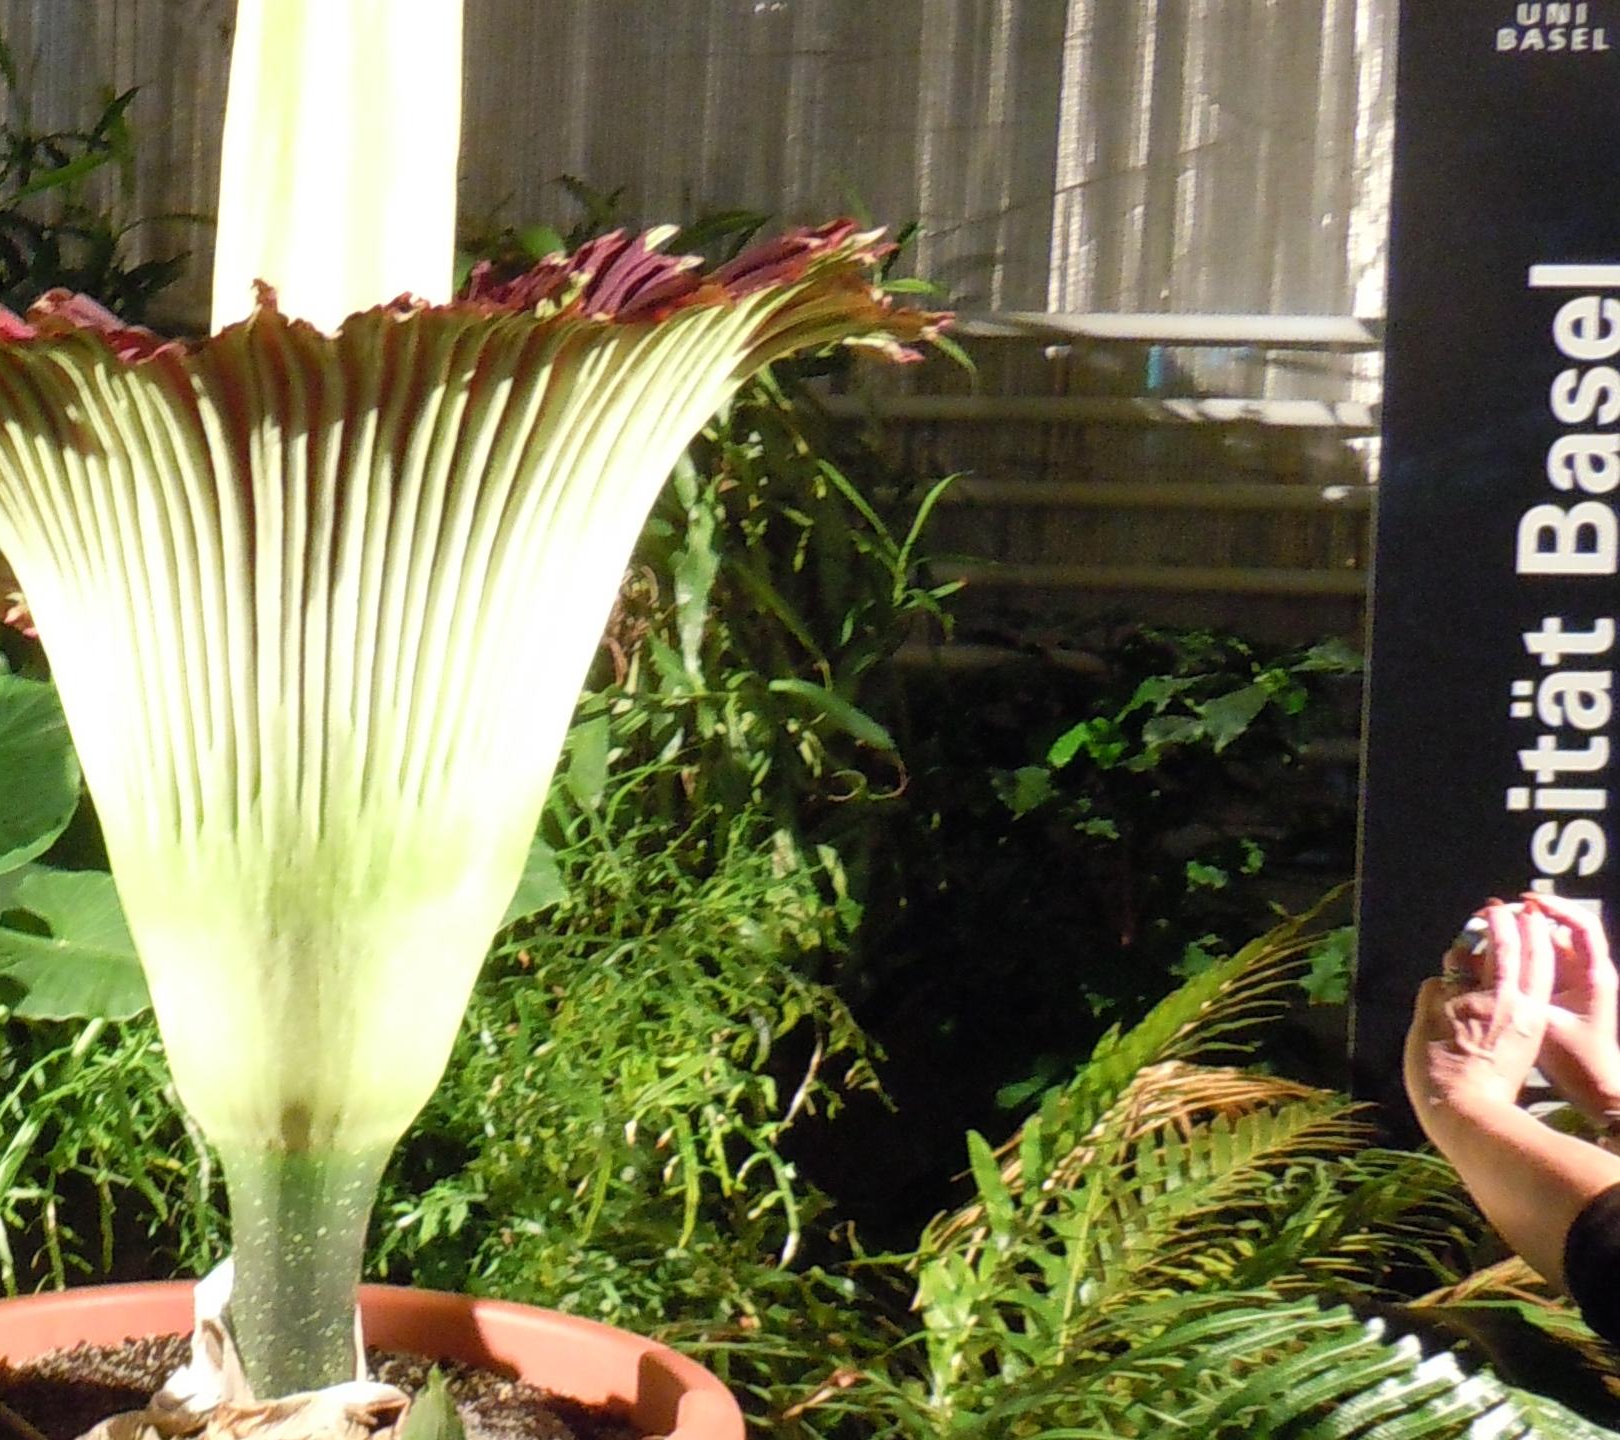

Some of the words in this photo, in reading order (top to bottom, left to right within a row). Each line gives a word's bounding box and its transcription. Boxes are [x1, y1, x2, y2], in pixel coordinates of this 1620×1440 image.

[1516, 2, 1588, 26] UNI
[1496, 27, 1610, 51] BASEL
[1515, 264, 1620, 574] Basel
